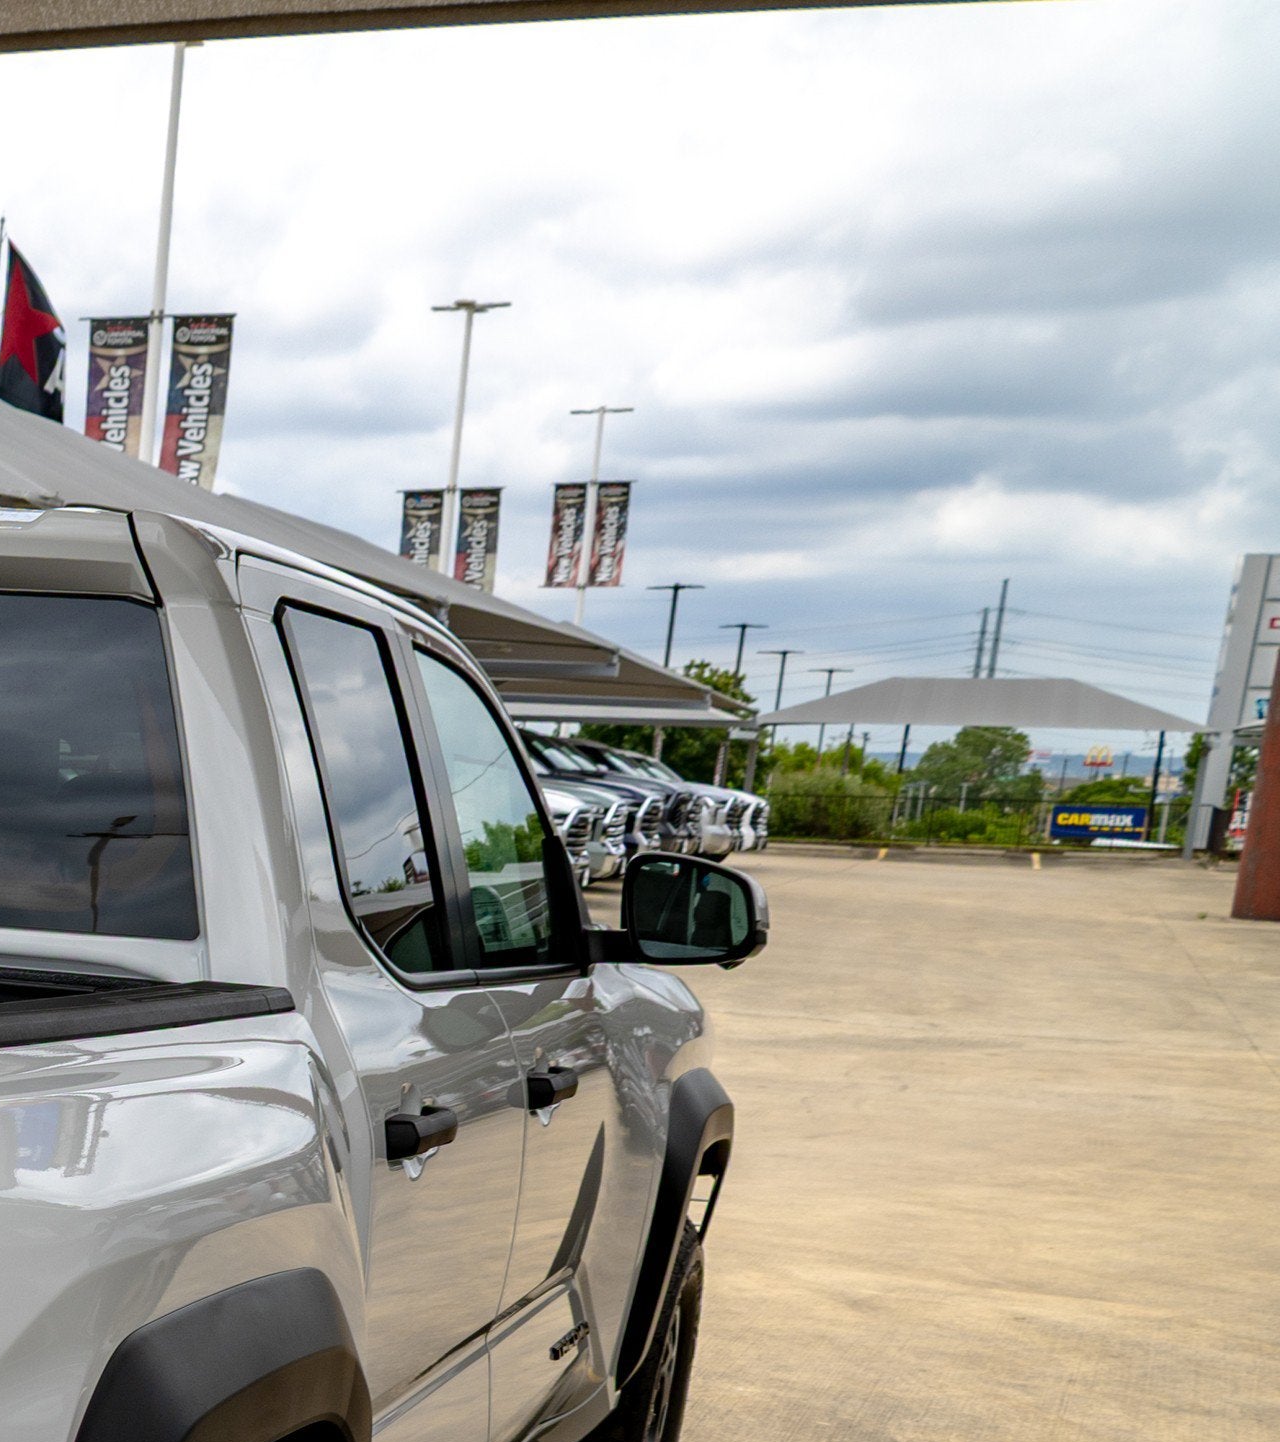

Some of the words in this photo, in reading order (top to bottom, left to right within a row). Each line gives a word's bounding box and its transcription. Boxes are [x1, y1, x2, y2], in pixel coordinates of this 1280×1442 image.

[176, 362, 213, 456] Vehicles
[409, 521, 432, 567] hicles
[464, 520, 488, 582] Vehicles
